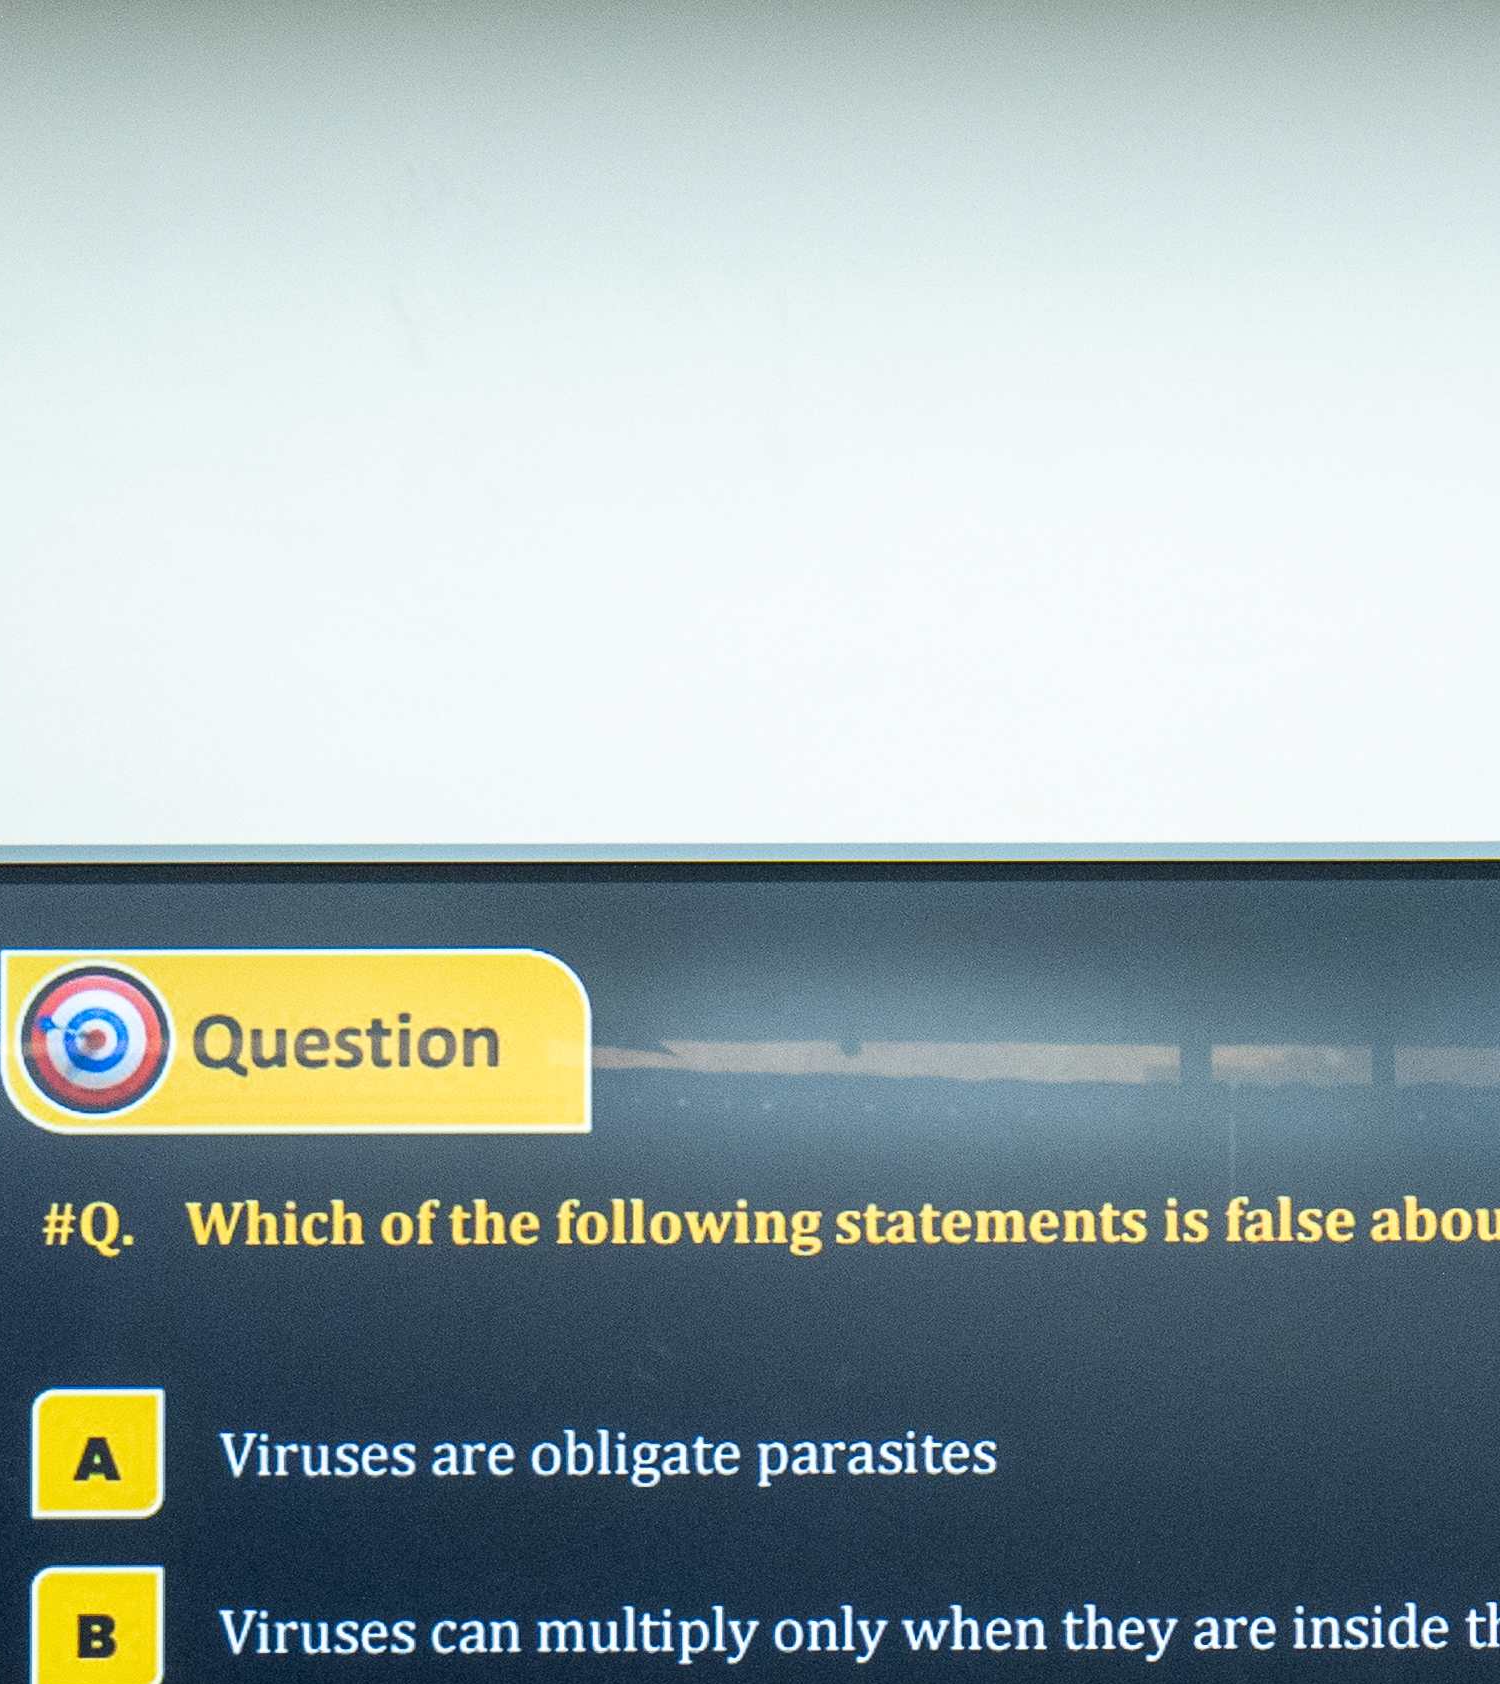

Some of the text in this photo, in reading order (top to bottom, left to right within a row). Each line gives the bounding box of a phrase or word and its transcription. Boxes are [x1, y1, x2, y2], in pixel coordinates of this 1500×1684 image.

[192, 1012, 500, 1078] Question
[42, 1201, 134, 1257] #Q.
[184, 1198, 365, 1246] Which
[380, 1198, 441, 1246] of
[448, 1198, 540, 1246] the
[556, 1197, 823, 1257] following
[835, 1201, 1148, 1245] statements
[1163, 1196, 1209, 1243] is
[1224, 1195, 1356, 1243] false
[74, 1437, 120, 1480] A
[219, 1428, 997, 1488] Viruses are obligate parasites
[78, 1614, 116, 1658] B
[218, 1609, 416, 1655] Viruses
[431, 1620, 522, 1655] can
[537, 1605, 760, 1665] multiply
[773, 1604, 889, 1664] only
[901, 1604, 1048, 1652] when
[1061, 1603, 1179, 1663] they
[1193, 1616, 1277, 1651] are
[1293, 1601, 1450, 1651] inside
